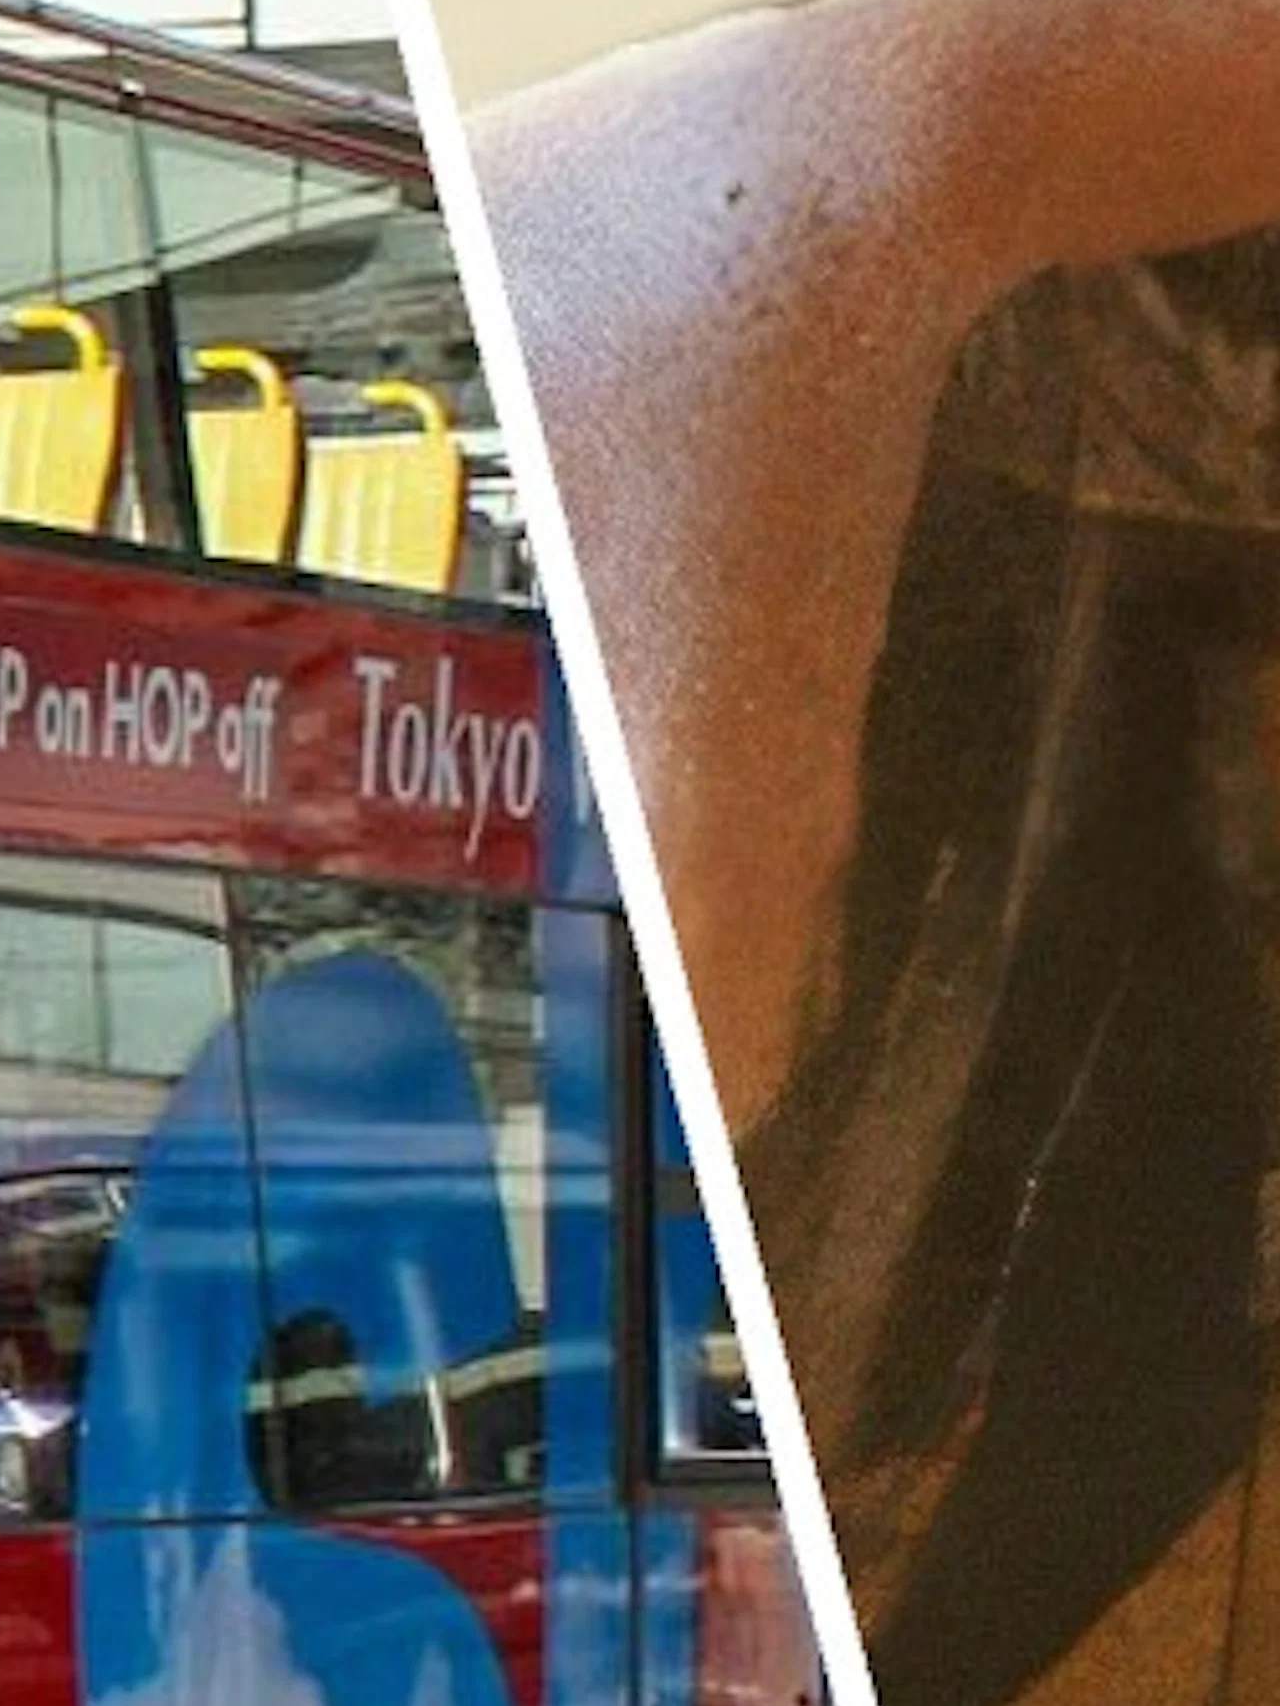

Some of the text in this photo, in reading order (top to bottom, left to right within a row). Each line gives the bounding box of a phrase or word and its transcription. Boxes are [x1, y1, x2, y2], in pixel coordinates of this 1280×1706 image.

[36, 687, 90, 757] on
[103, 659, 211, 769] HOP
[219, 675, 282, 801] off
[354, 655, 542, 863] Tokyo
